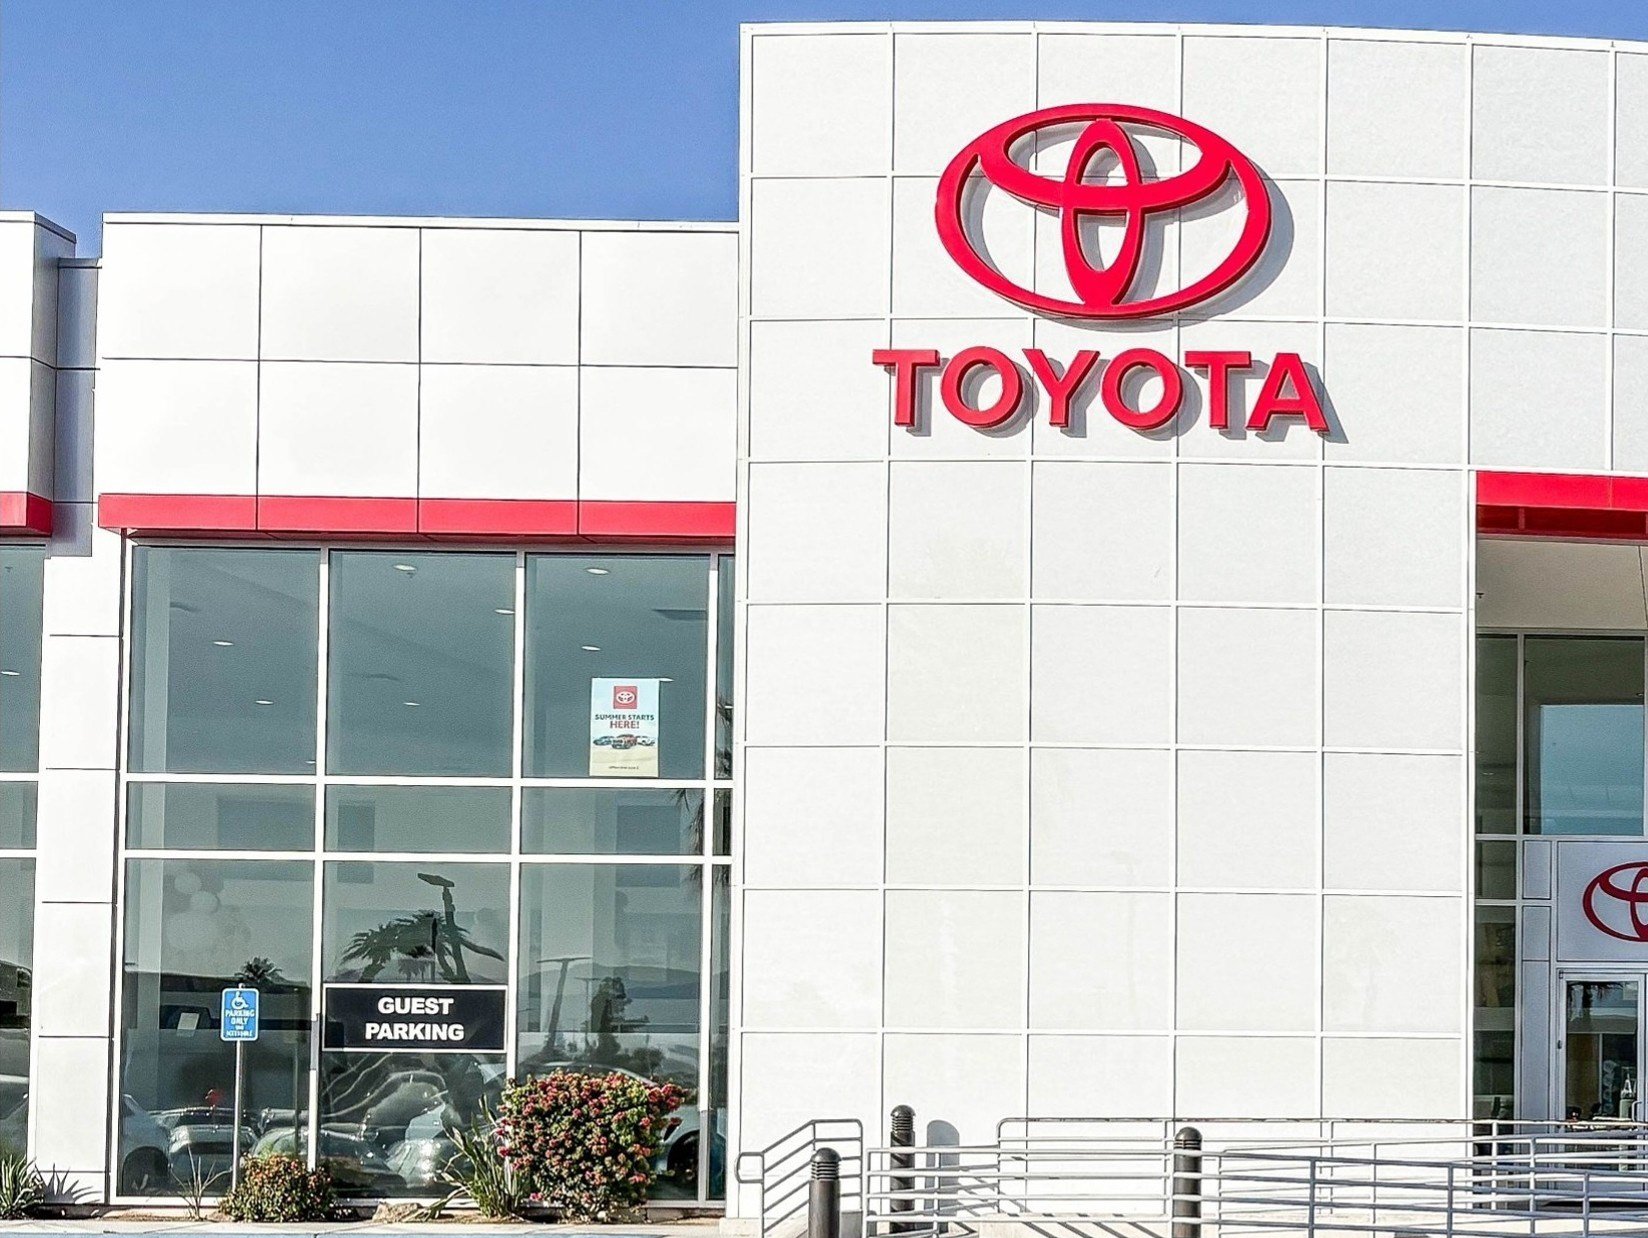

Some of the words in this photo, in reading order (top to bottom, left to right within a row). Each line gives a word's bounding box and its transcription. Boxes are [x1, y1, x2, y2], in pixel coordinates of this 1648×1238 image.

[872, 346, 1330, 436] TOYOTA
[610, 720, 640, 729] HERE!
[377, 997, 454, 1015] GUEST
[225, 1009, 255, 1018] PARKING
[231, 1016, 248, 1025] ONLY
[365, 1023, 465, 1041] PARKING
